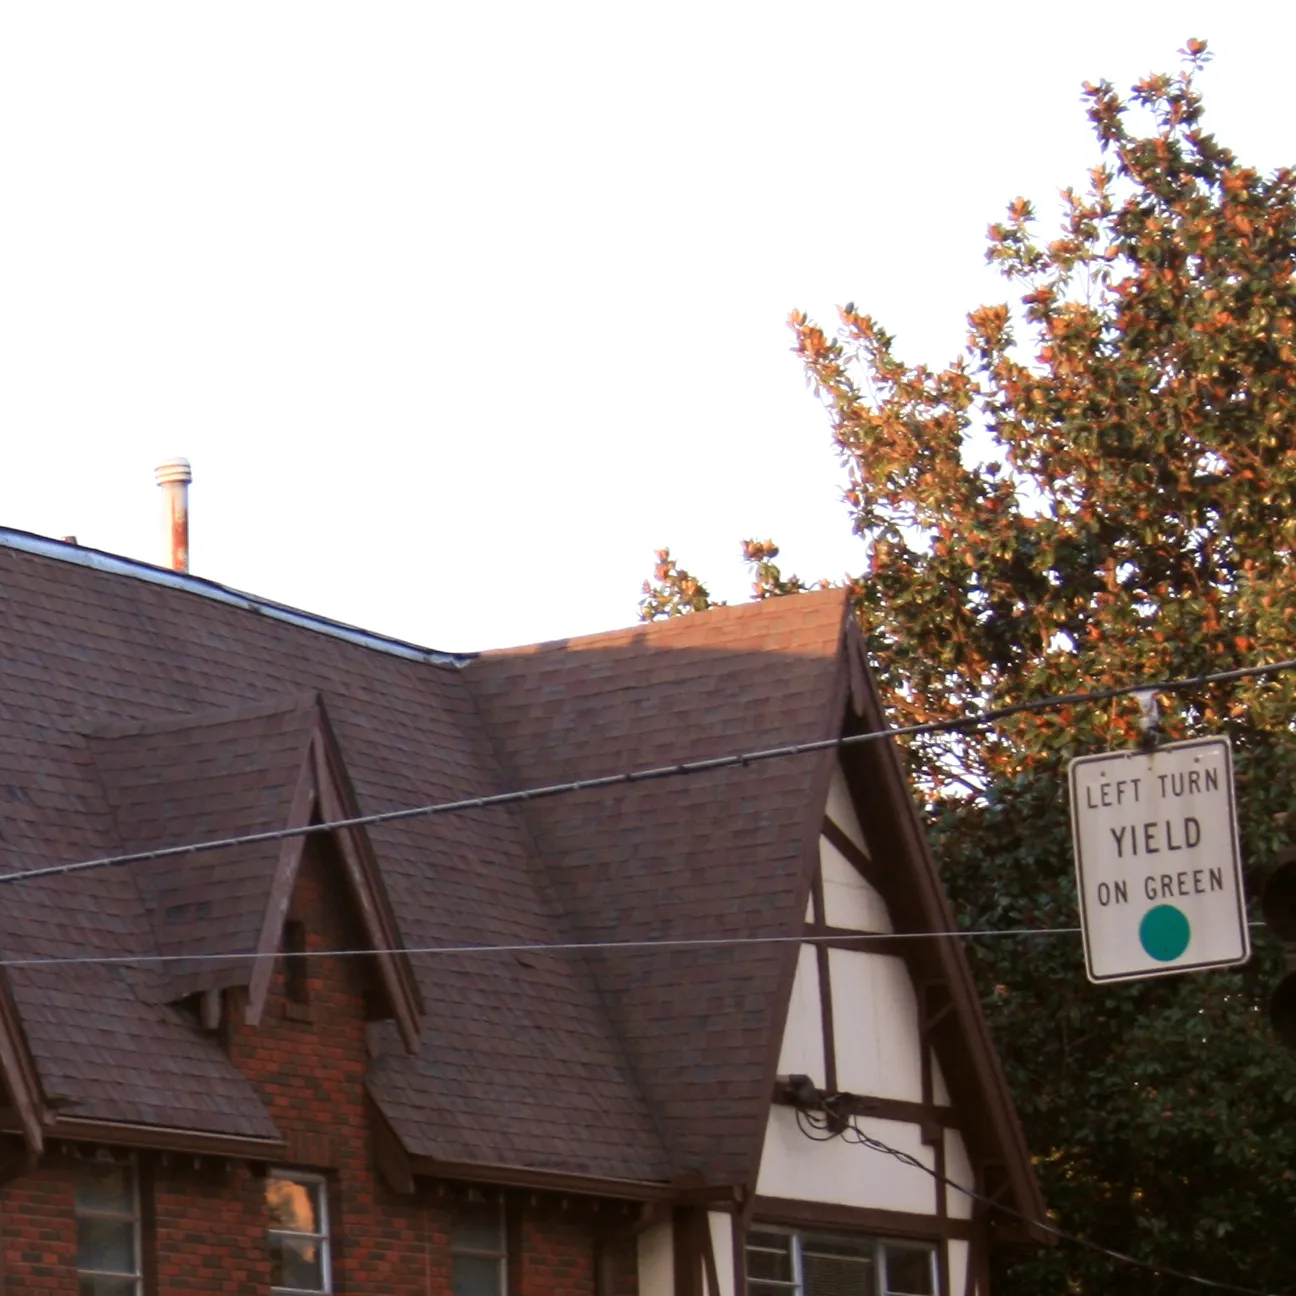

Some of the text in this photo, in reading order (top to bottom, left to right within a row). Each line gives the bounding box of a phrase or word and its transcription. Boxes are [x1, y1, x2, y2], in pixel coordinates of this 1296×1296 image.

[1086, 767, 1219, 809] LEFT TURN
[1110, 817, 1202, 858] YIELD
[1097, 867, 1224, 906] ON GREEN
